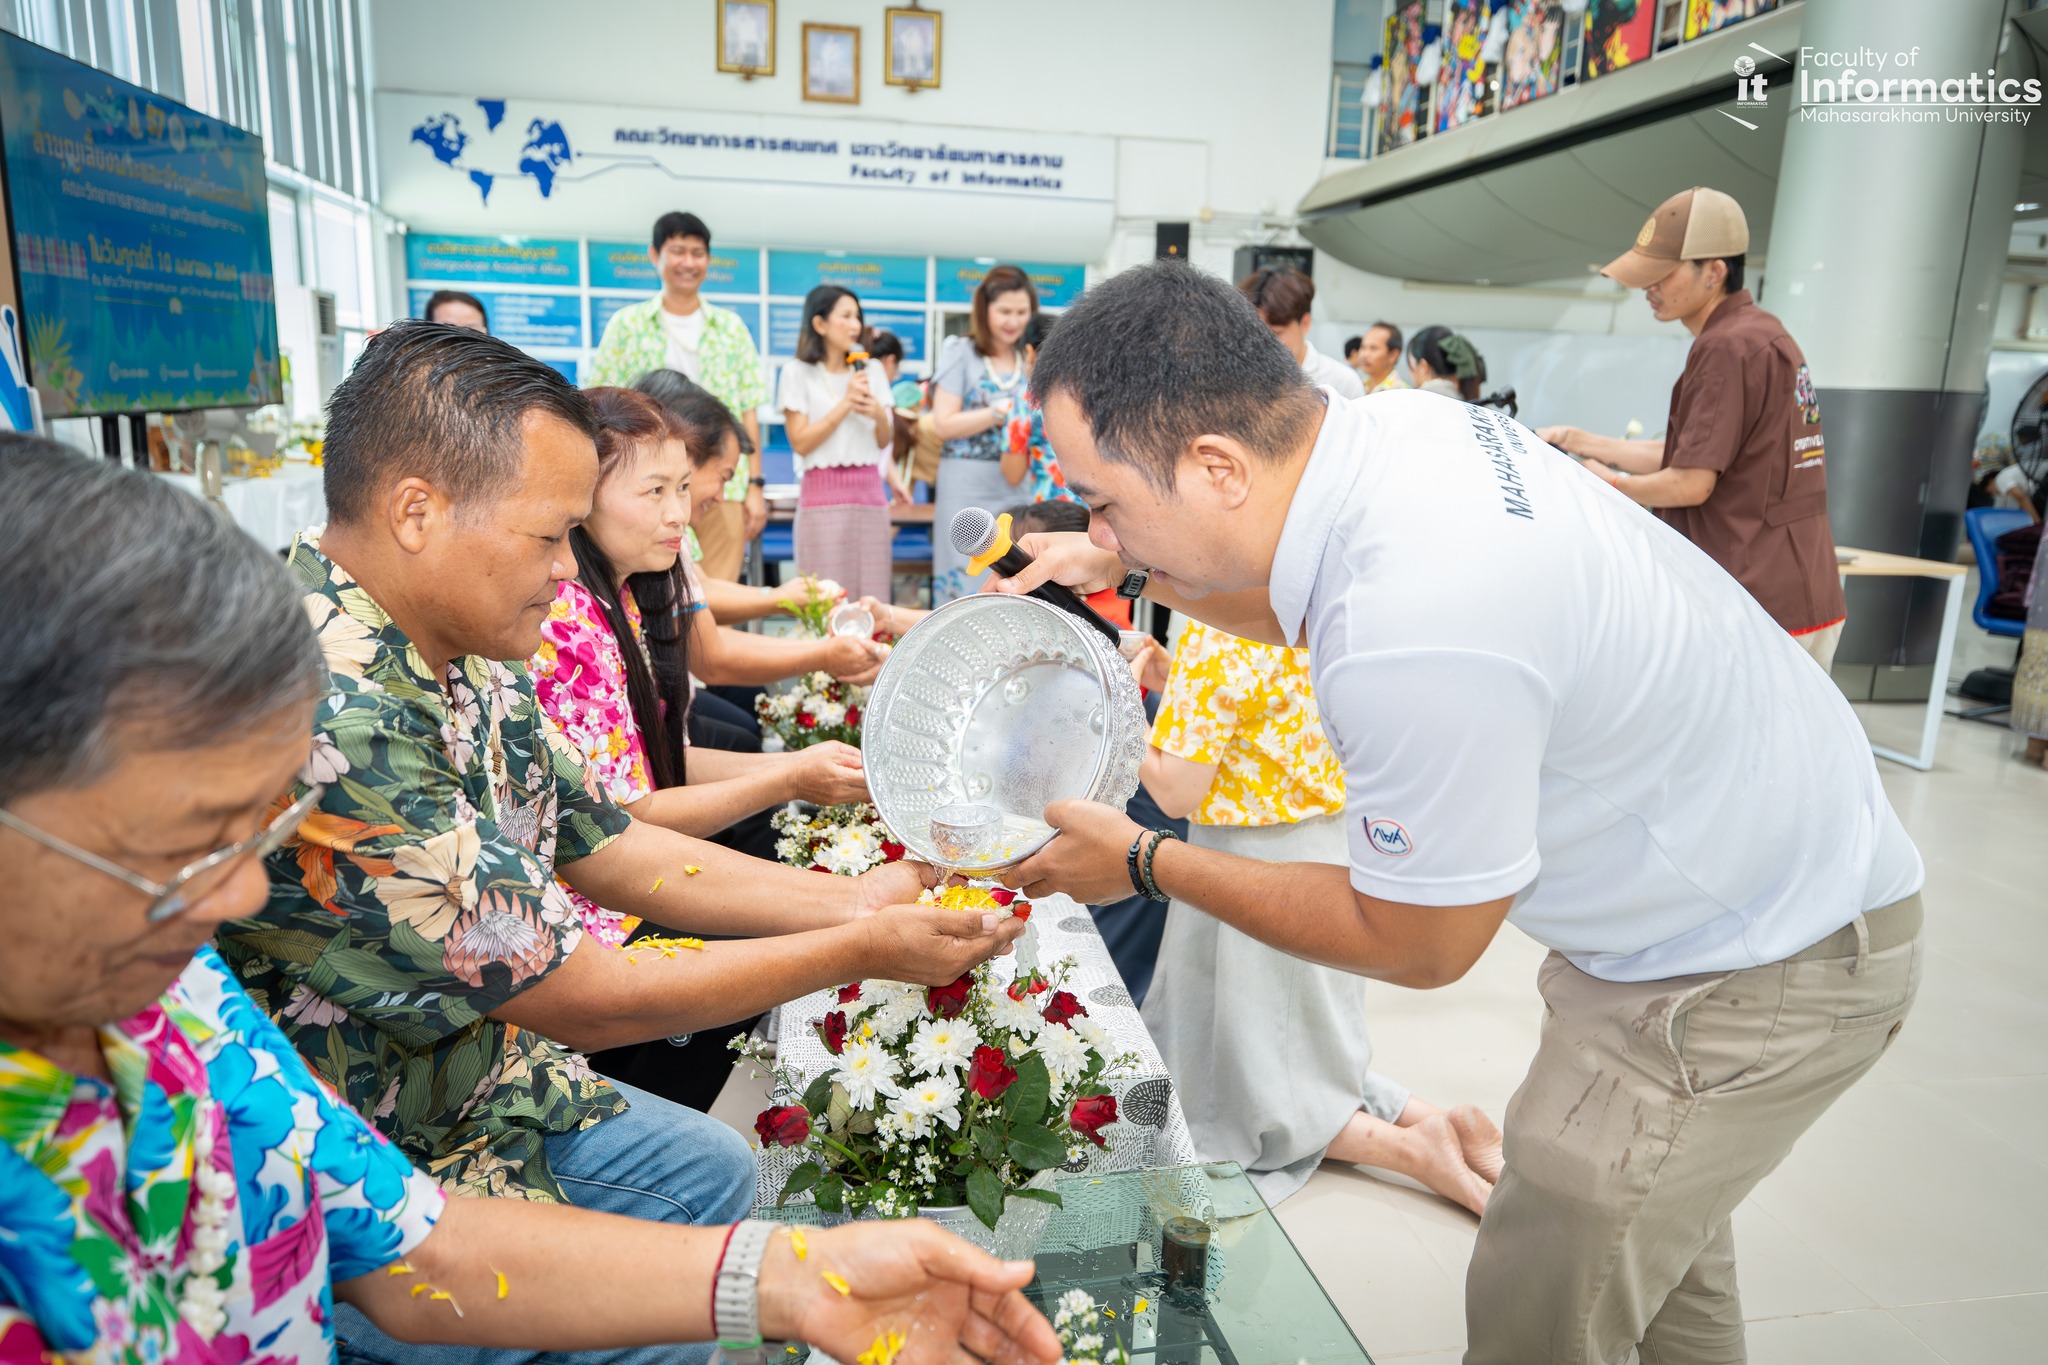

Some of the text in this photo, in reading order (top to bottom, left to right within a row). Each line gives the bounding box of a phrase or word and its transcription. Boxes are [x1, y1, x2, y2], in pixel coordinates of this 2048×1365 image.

[614, 126, 1063, 169] คณะวิทยาการสารสนเทศ มหาวิทยาลัยมหาสารคาม
[850, 165, 915, 183] Faculty
[930, 169, 949, 182] of
